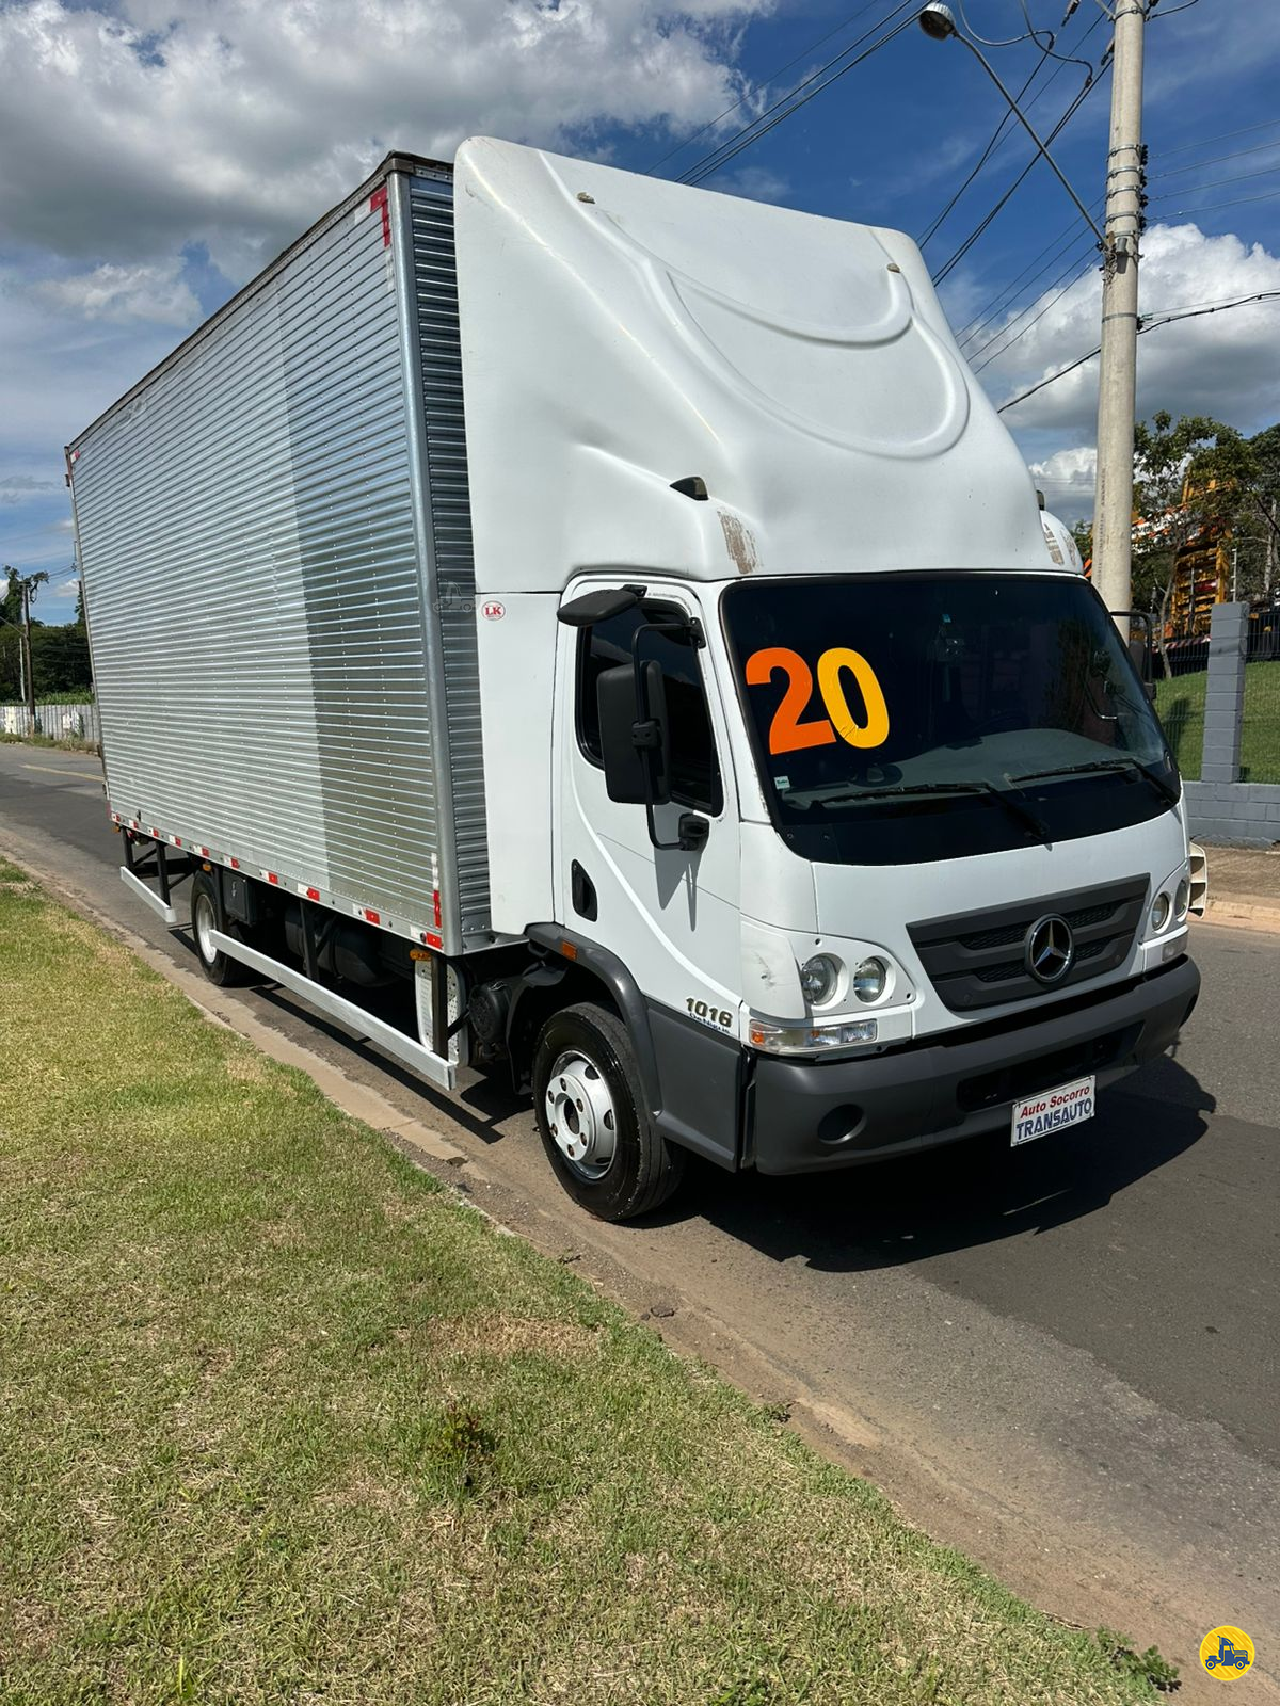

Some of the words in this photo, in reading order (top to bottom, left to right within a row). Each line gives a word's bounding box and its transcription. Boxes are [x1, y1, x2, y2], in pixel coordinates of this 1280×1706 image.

[485, 606, 502, 615] LK
[746, 647, 889, 755] 20
[686, 997, 733, 1028] 1016
[1020, 1102, 1046, 1118] Auto
[1050, 1086, 1090, 1108] Socorro
[1016, 1097, 1093, 1140] TRANSAUTO
